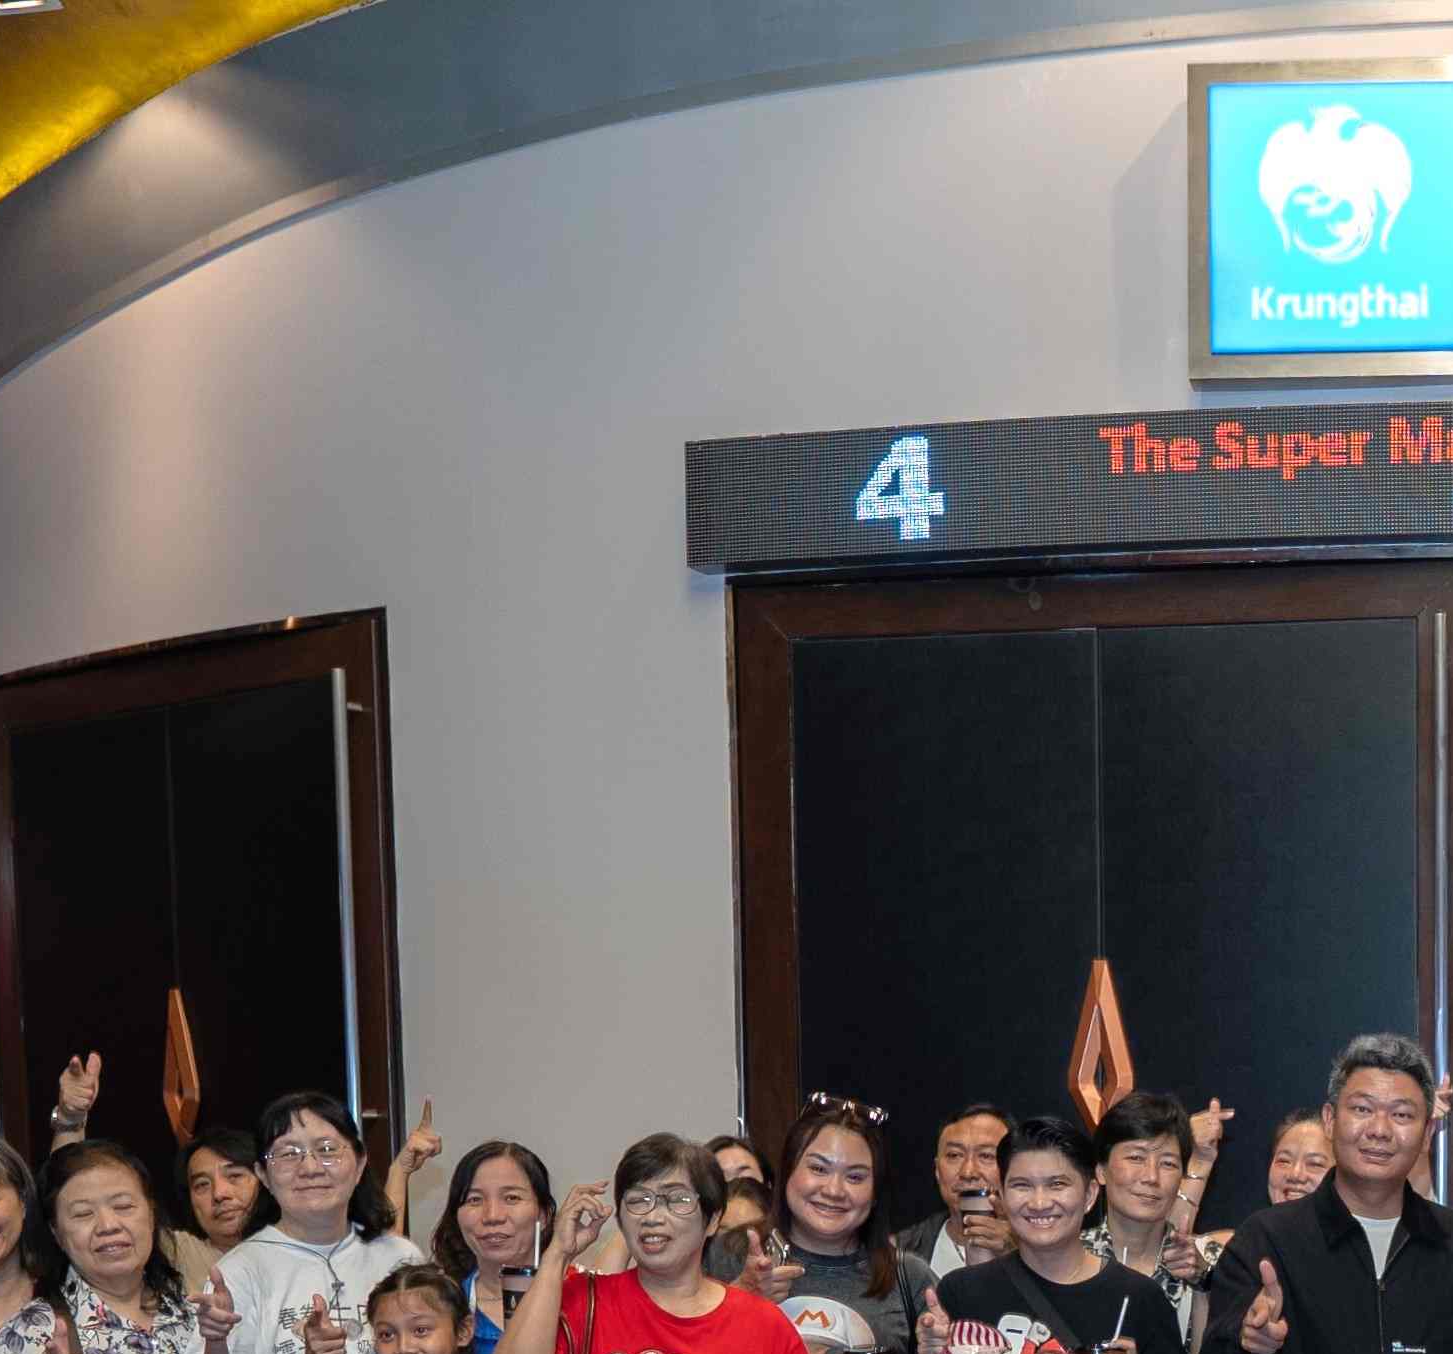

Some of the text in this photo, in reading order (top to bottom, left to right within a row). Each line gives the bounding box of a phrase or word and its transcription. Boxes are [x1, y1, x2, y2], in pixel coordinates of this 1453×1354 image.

[1250, 284, 1429, 328] Krungthai
[1100, 421, 1198, 475] The
[1210, 419, 1374, 480] Super
[856, 434, 945, 541] 4
